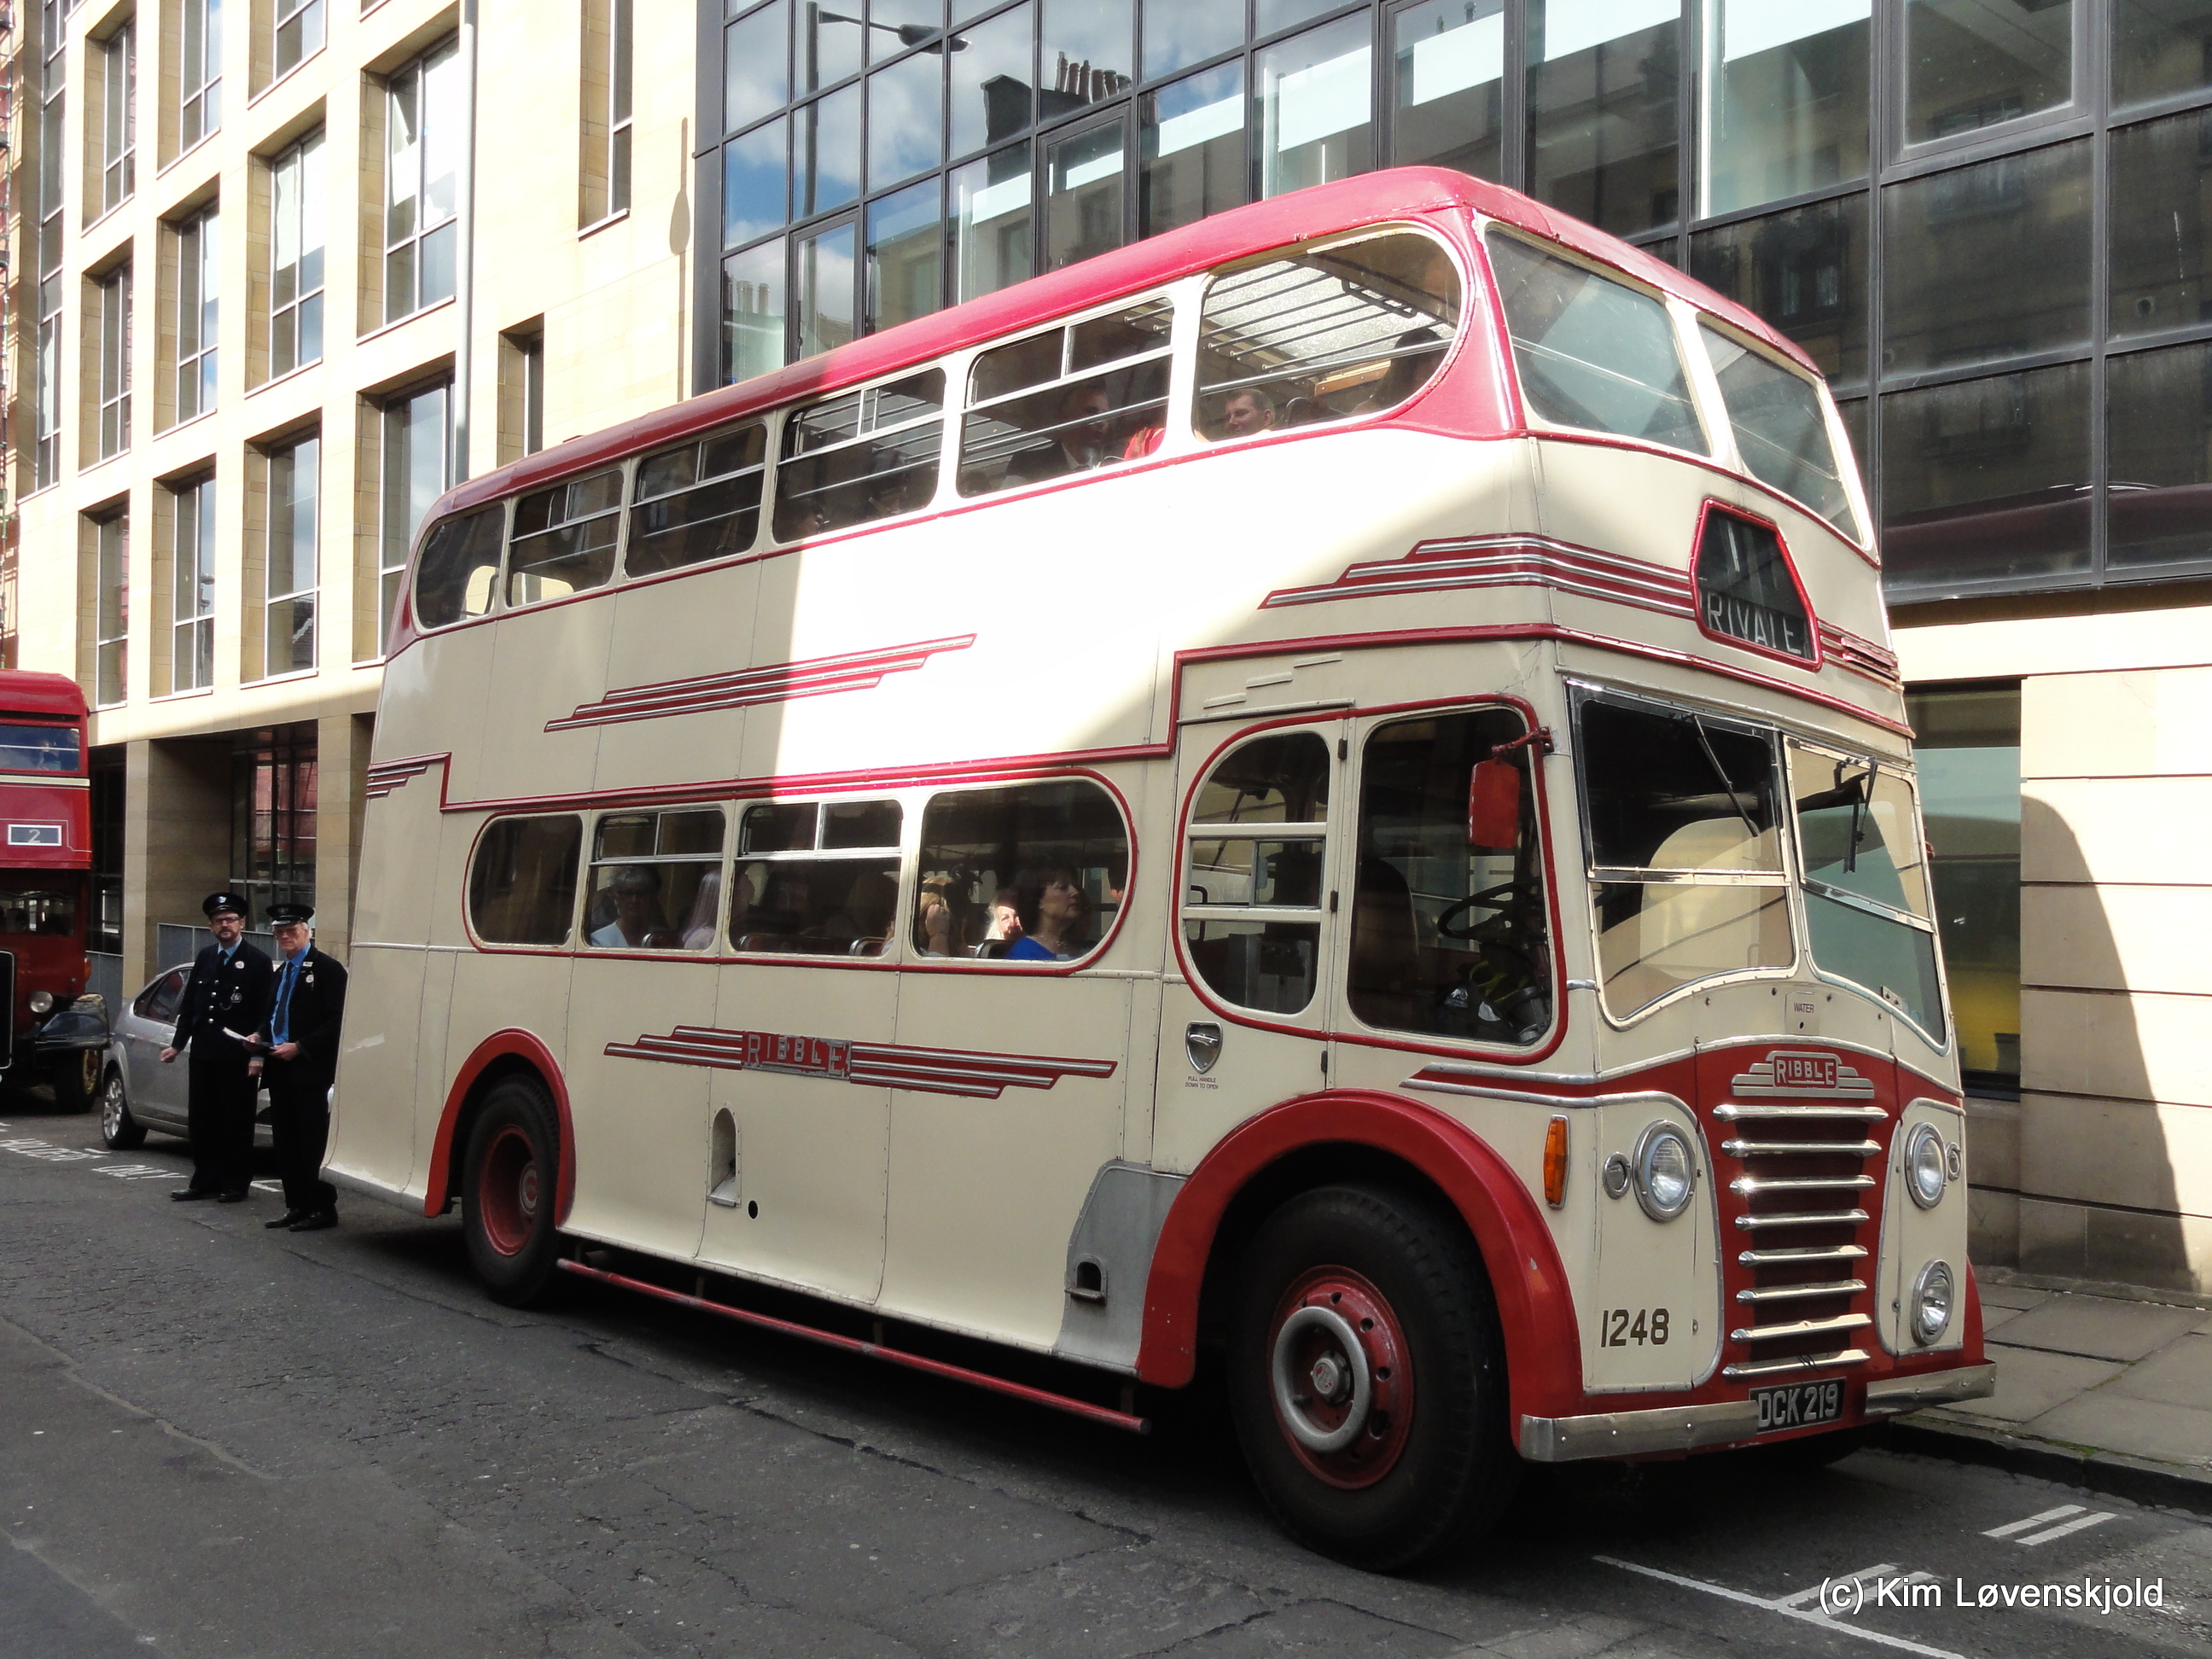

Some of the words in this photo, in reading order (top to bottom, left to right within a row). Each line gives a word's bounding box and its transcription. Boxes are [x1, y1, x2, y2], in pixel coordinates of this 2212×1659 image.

[1699, 591, 1802, 655] RIVATE
[27, 829, 41, 843] 2
[1793, 1002, 1814, 1014] WATER
[747, 1033, 847, 1076] RIBBLE
[1776, 1059, 1835, 1086] RIBBLE
[1601, 1308, 1670, 1348] 1248
[1757, 1391, 1799, 1428] DCK
[1804, 1383, 1839, 1422] 219
